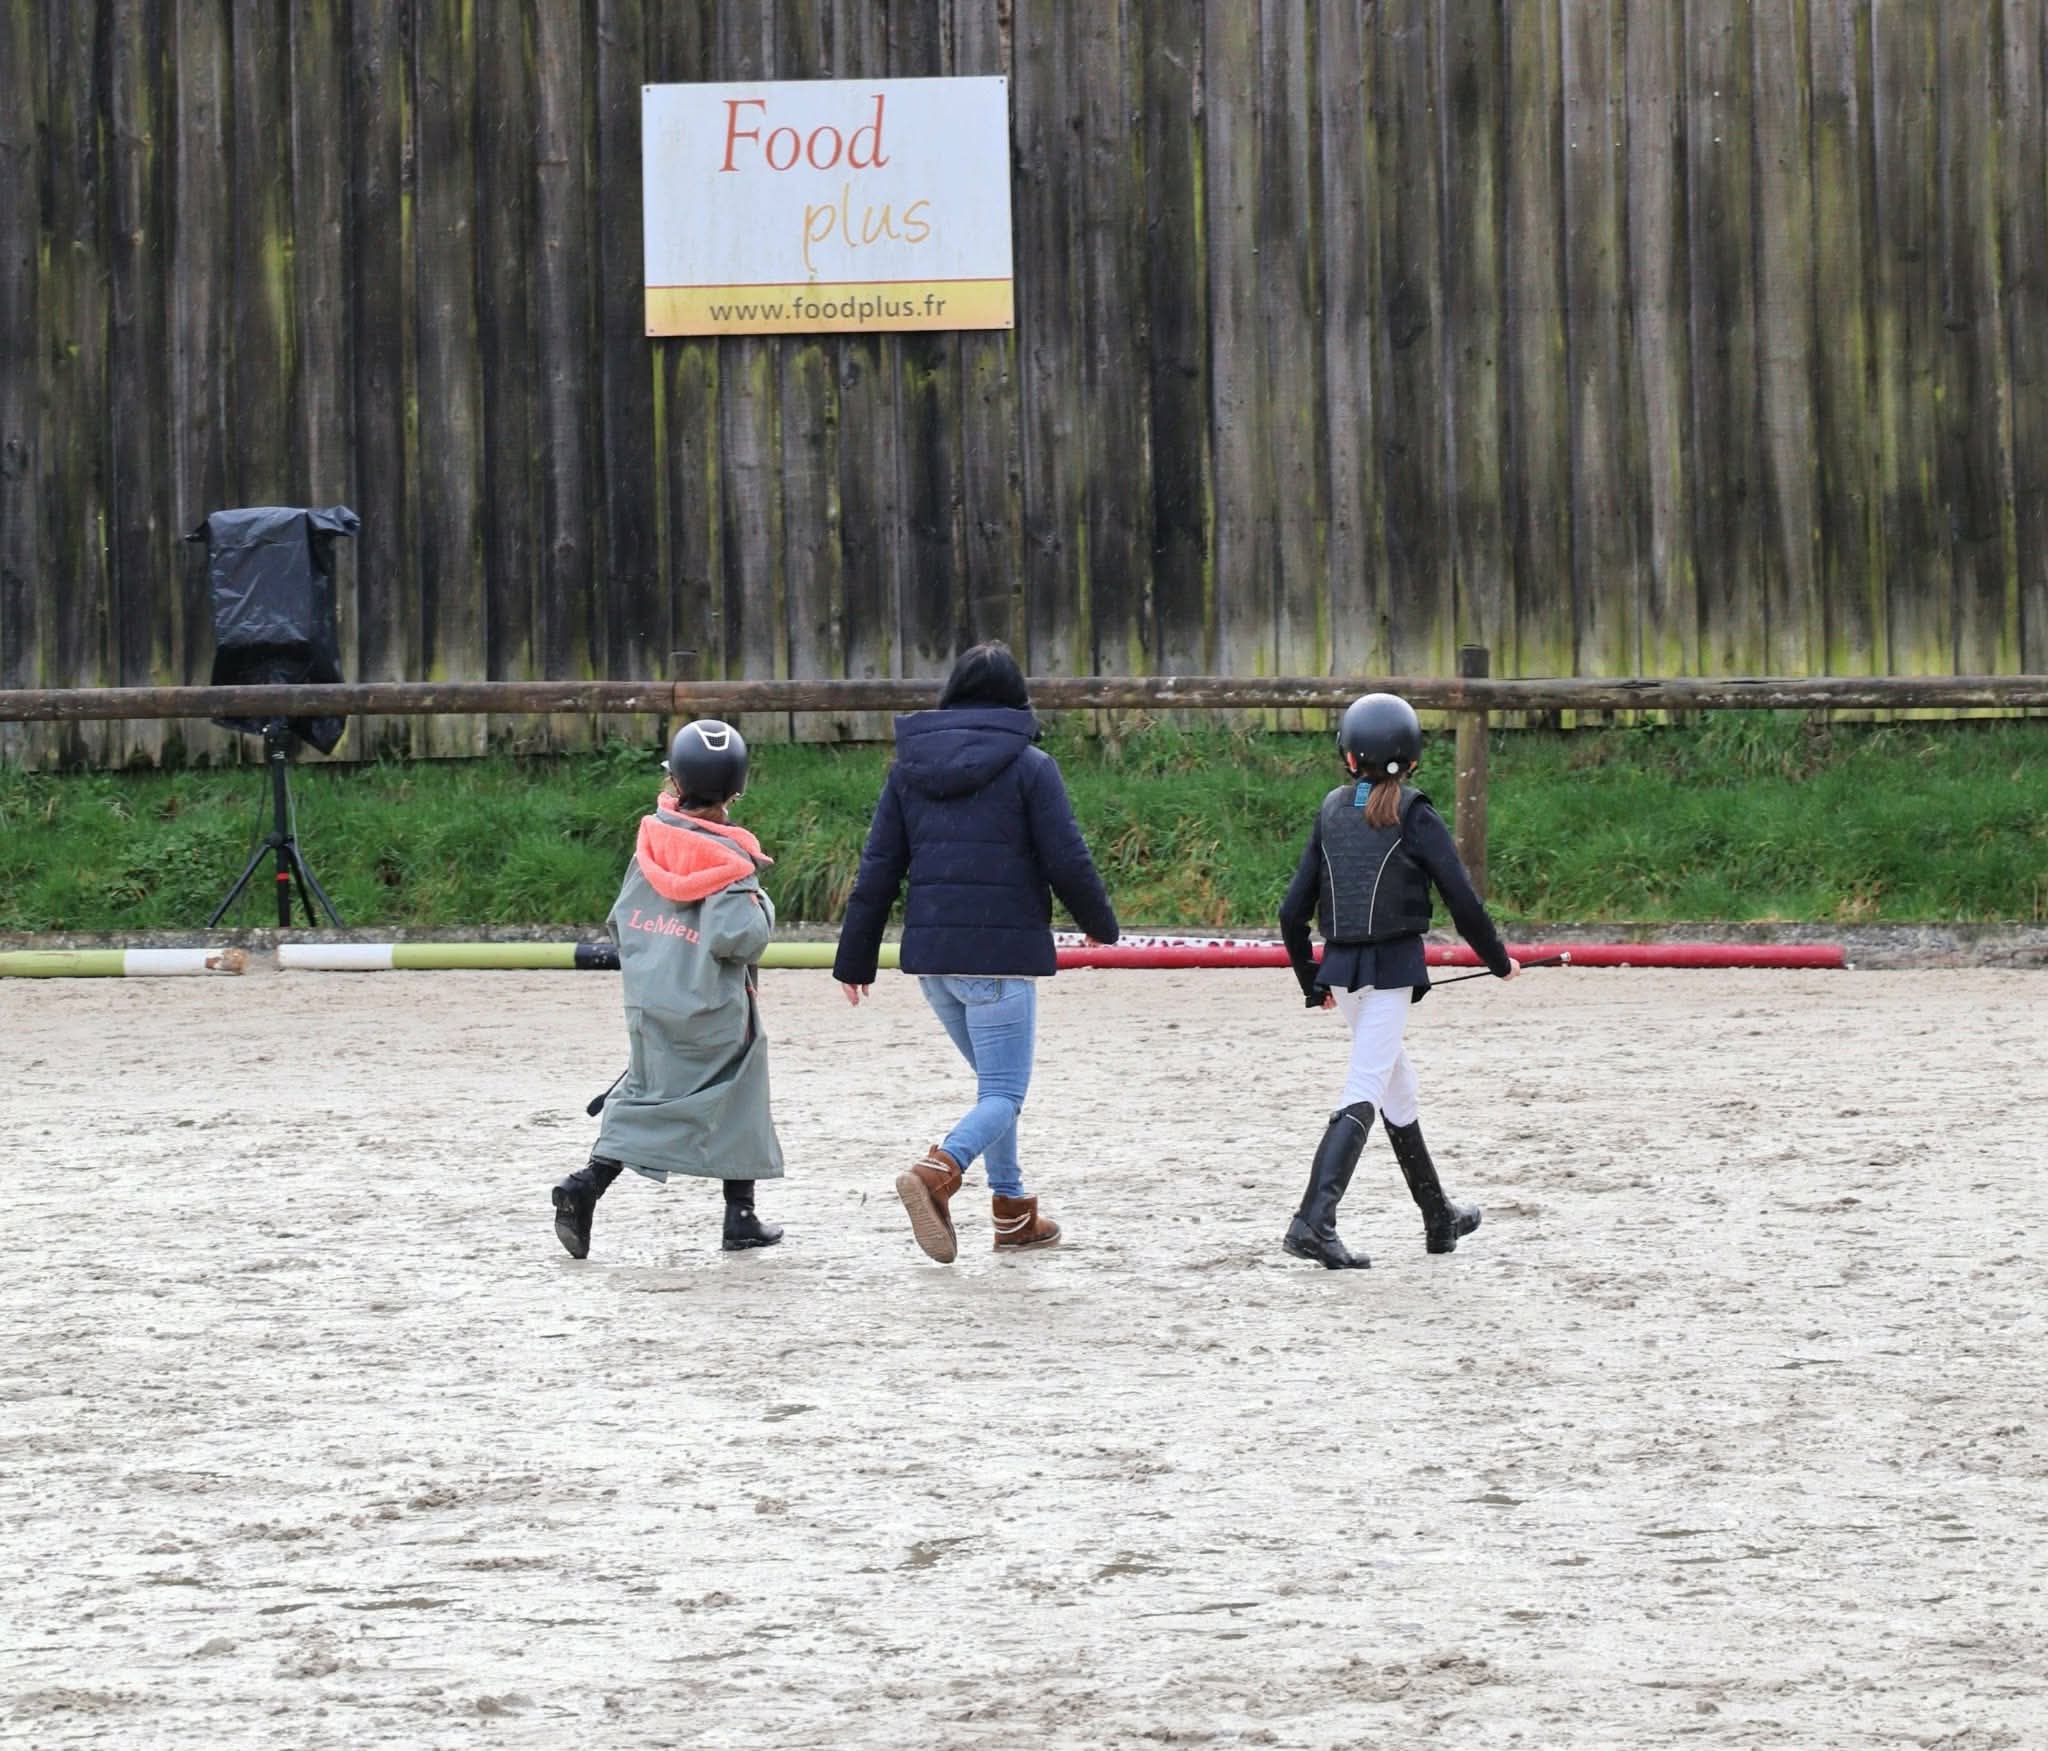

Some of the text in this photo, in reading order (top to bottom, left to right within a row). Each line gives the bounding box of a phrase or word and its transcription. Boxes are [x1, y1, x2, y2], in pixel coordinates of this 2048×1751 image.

[719, 94, 890, 172] Food
[803, 183, 932, 273] plus
[709, 294, 947, 324] www.foodplus.fr
[628, 909, 701, 944] LeMieu
